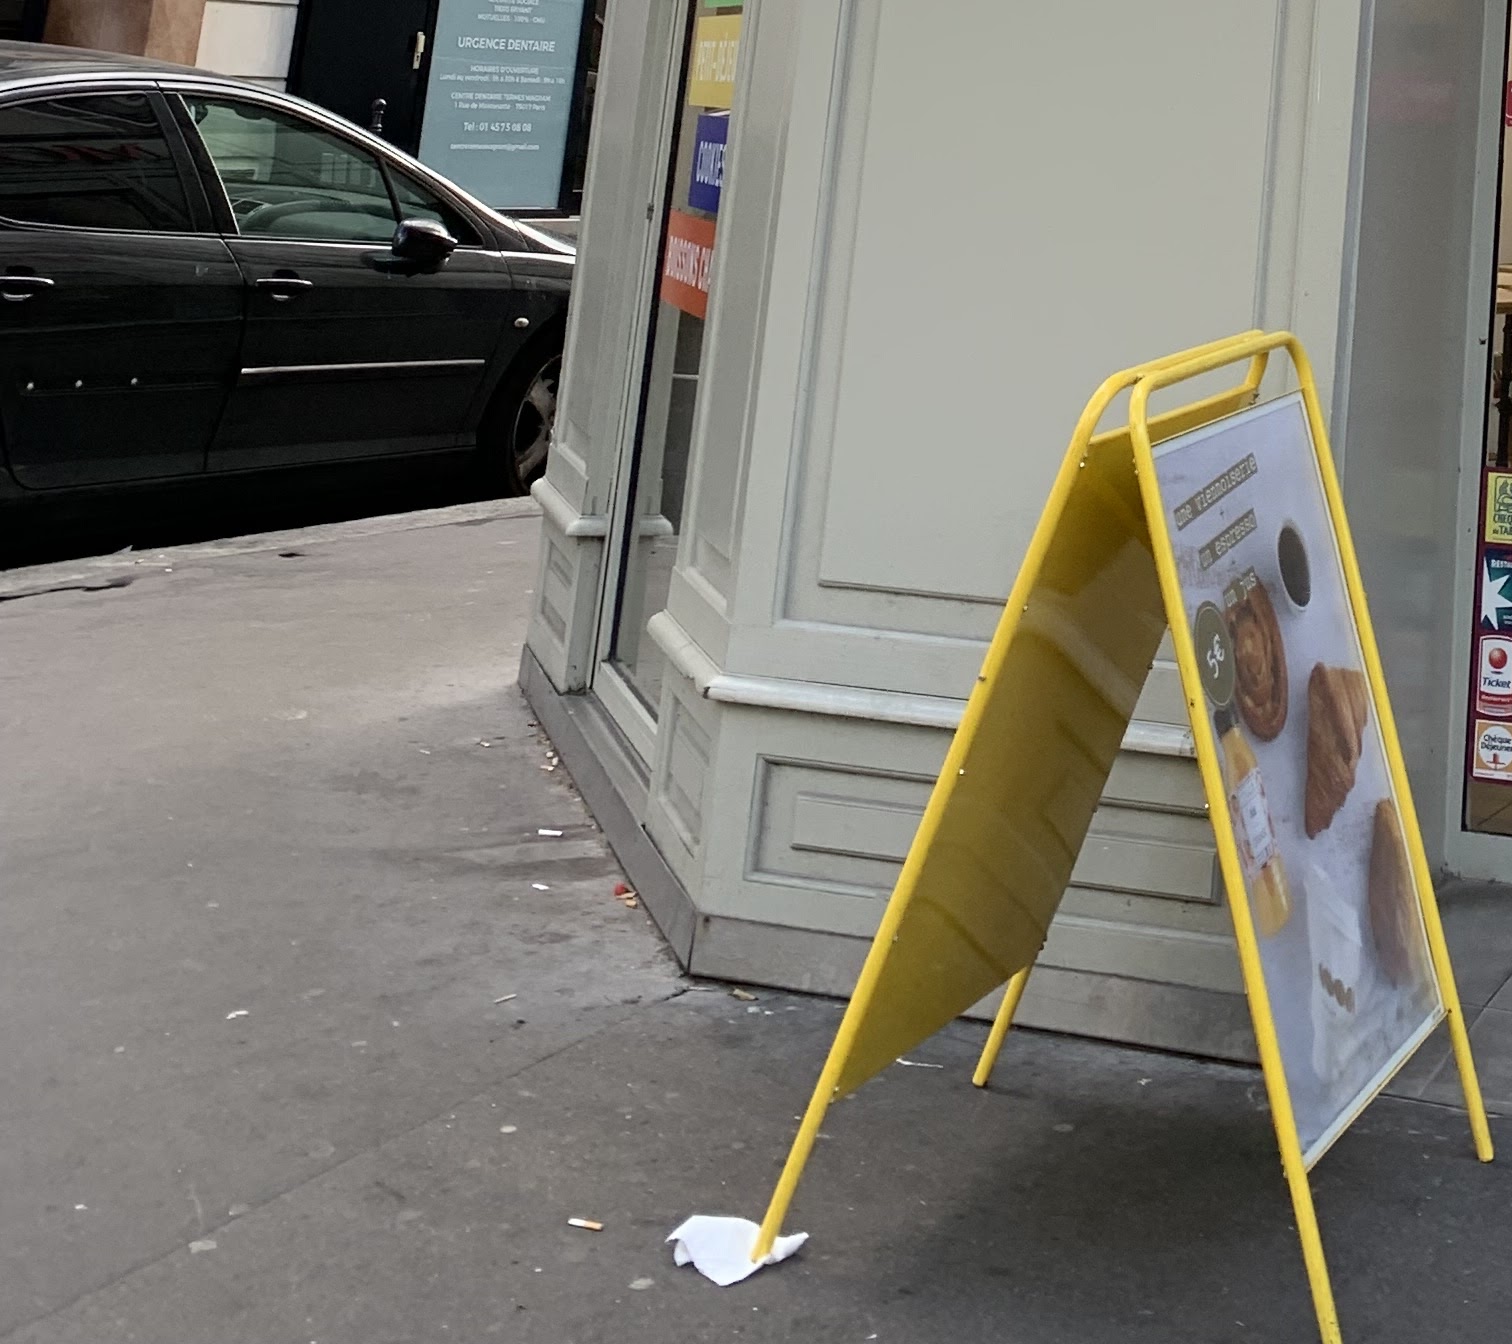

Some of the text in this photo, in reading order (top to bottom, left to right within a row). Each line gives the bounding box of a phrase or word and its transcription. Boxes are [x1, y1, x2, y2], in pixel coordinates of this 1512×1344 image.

[457, 36, 556, 52] URGENCE DENTAIRE
[1175, 503, 1193, 527] une
[1214, 511, 1256, 556] espresso
[1239, 570, 1257, 600] jus
[1482, 676, 1512, 689] Ticket
